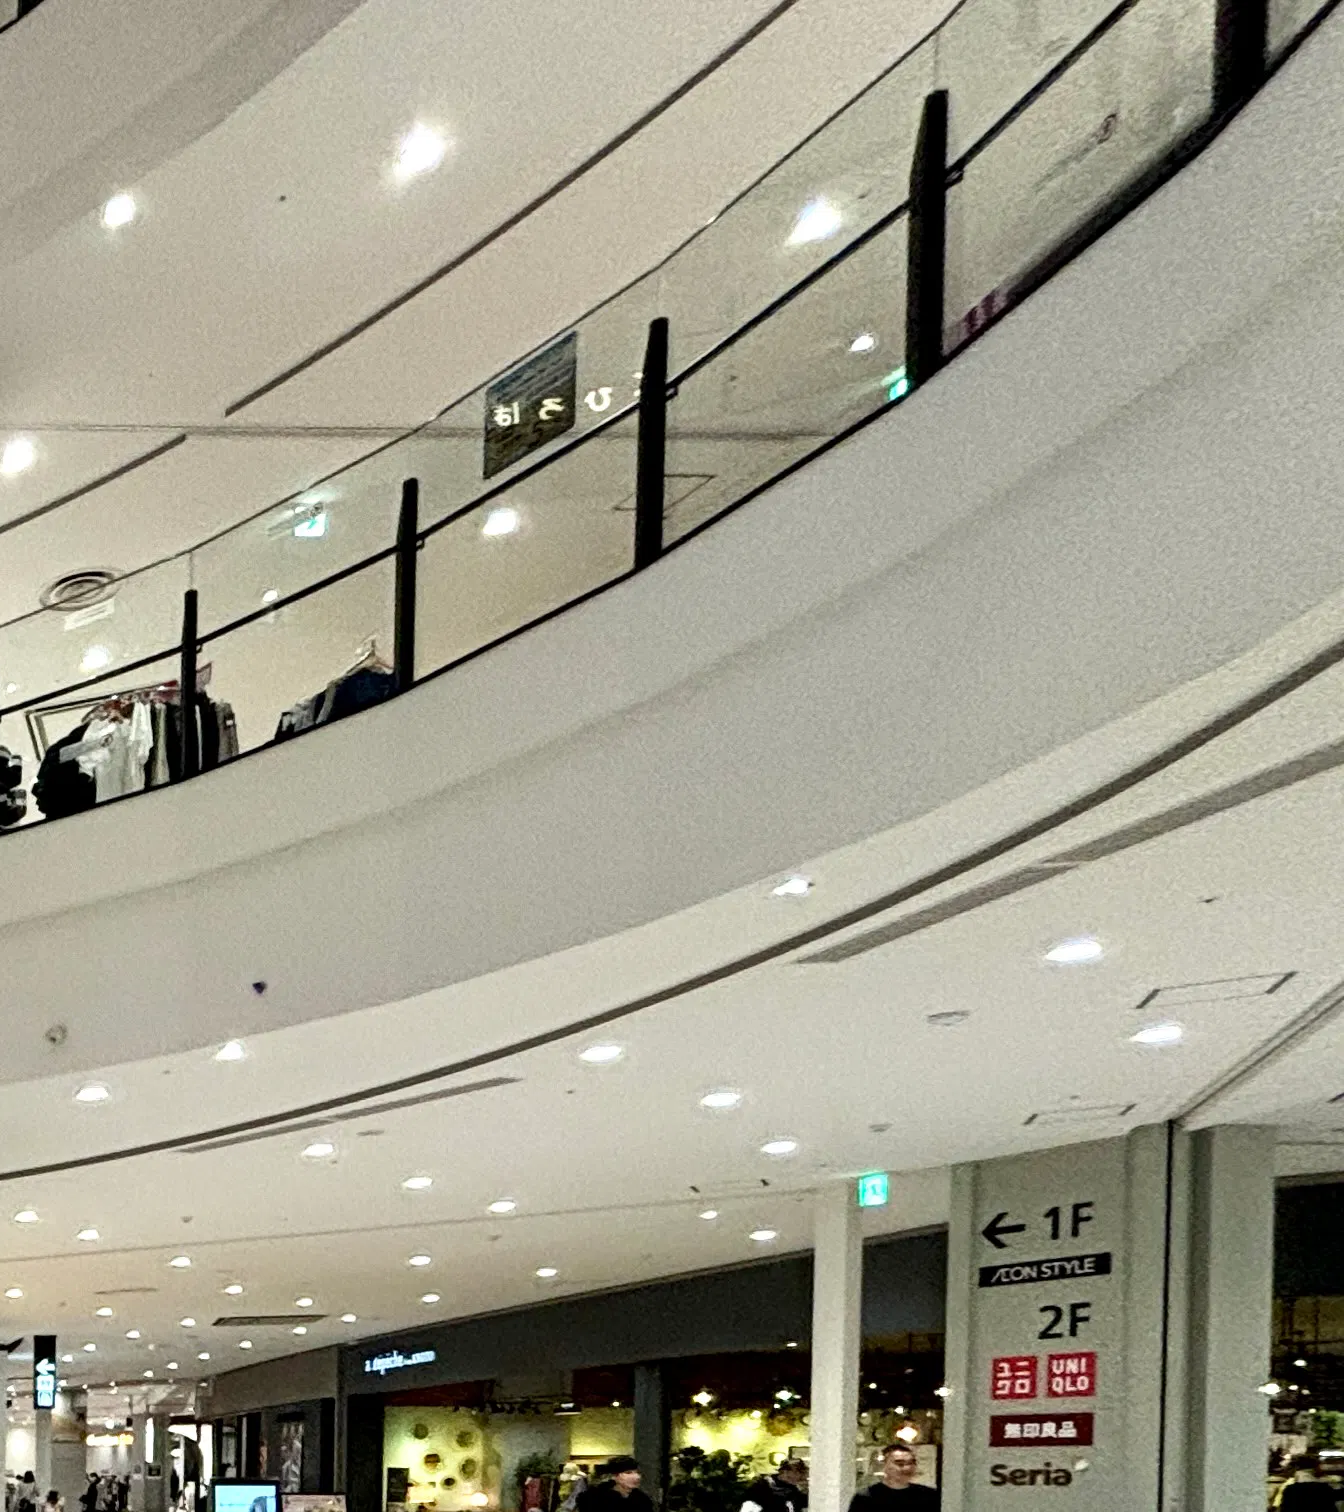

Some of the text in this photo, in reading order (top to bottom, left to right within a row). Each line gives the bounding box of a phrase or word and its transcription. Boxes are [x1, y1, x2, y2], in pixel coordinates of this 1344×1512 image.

[1043, 1201, 1094, 1240] 1F
[1040, 1257, 1097, 1278] STYLE
[1037, 1302, 1091, 1340] 2F
[1052, 1357, 1088, 1375] UNI
[1052, 1375, 1090, 1395] QLO
[1003, 1421, 1078, 1440] 無印良品
[990, 1461, 1073, 1487] Seria
